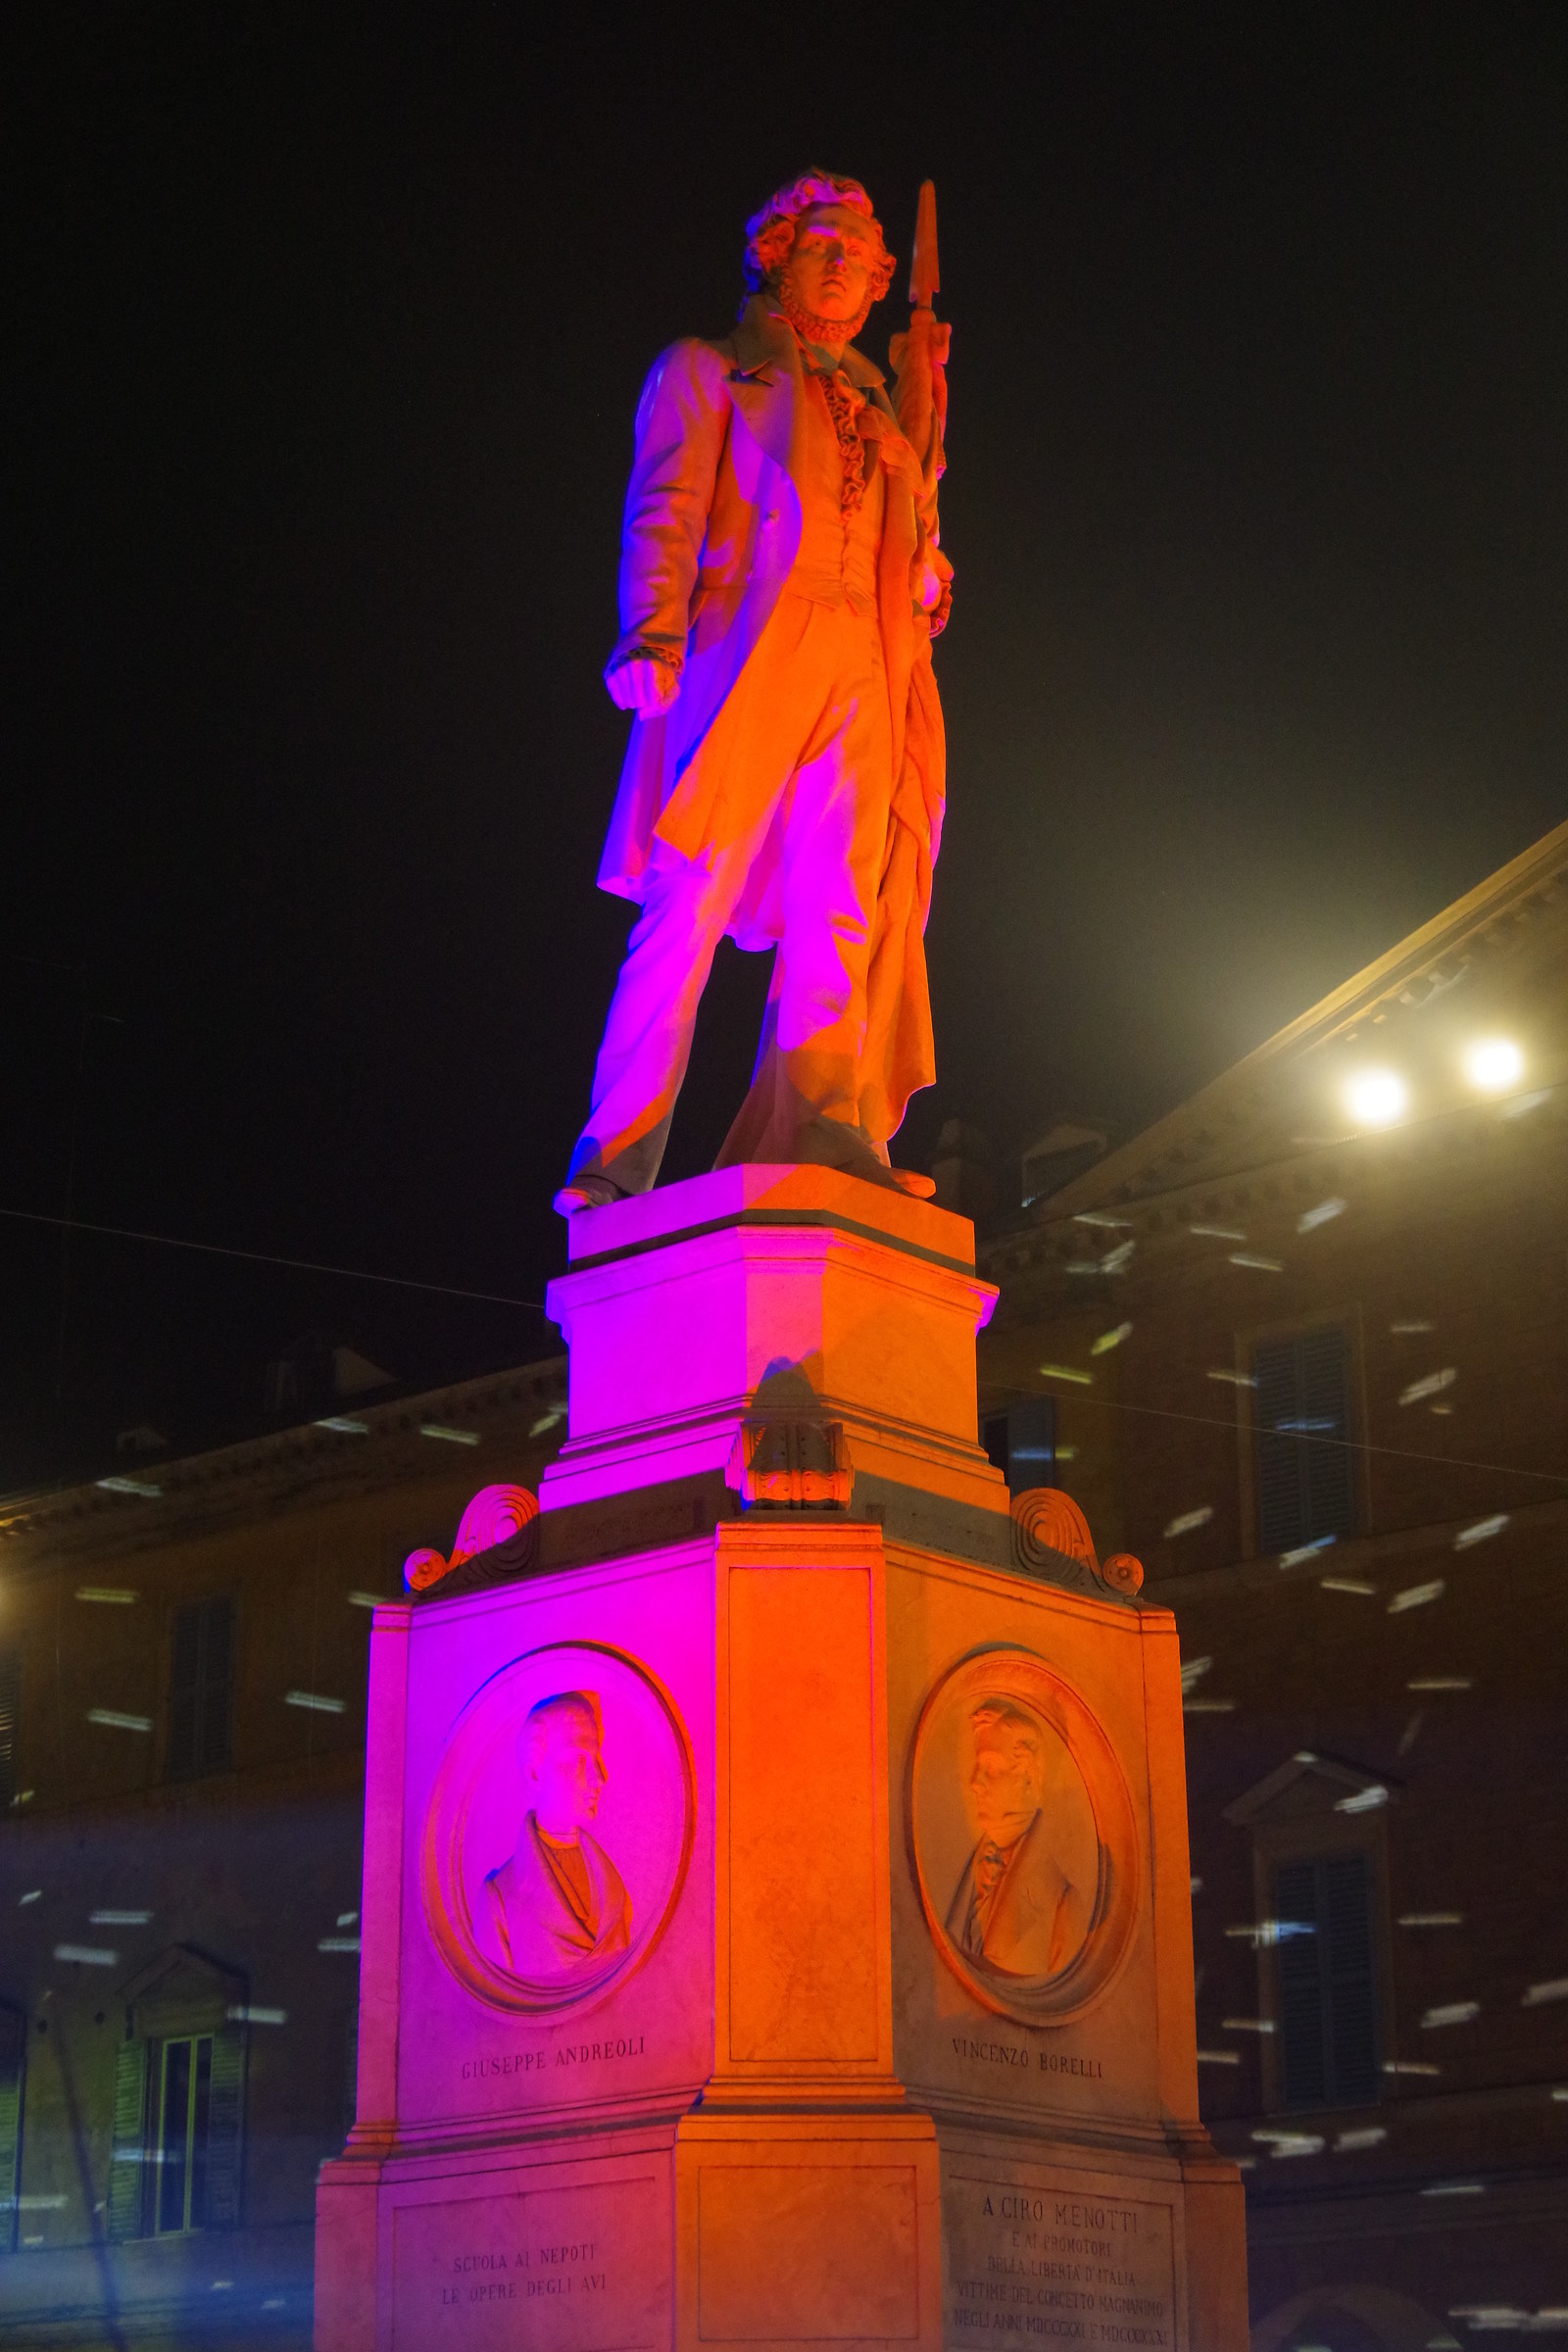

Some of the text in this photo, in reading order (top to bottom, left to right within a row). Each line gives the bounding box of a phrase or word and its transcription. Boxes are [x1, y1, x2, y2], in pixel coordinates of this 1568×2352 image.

[462, 2036, 644, 2080] GIUSEPPE ANDREOLI
[953, 2038, 1102, 2079] VINCENZO BORELLI
[983, 2195, 1138, 2233] A CIRO MENOTTI
[454, 2243, 594, 2274] SCUOLA AI NEPOTI
[1012, 2231, 1111, 2258] E AI PROMOTORI
[988, 2255, 1026, 2276] DELLA
[442, 2273, 607, 2305] LE OPERE DEGLI AVI
[956, 2280, 1006, 2302] VITTIME
[1012, 2285, 1033, 2305] DEL
[1037, 2289, 1095, 2311] CONCETTO
[954, 2308, 990, 2329] NEGLI
[993, 2312, 1022, 2331] ANNI
